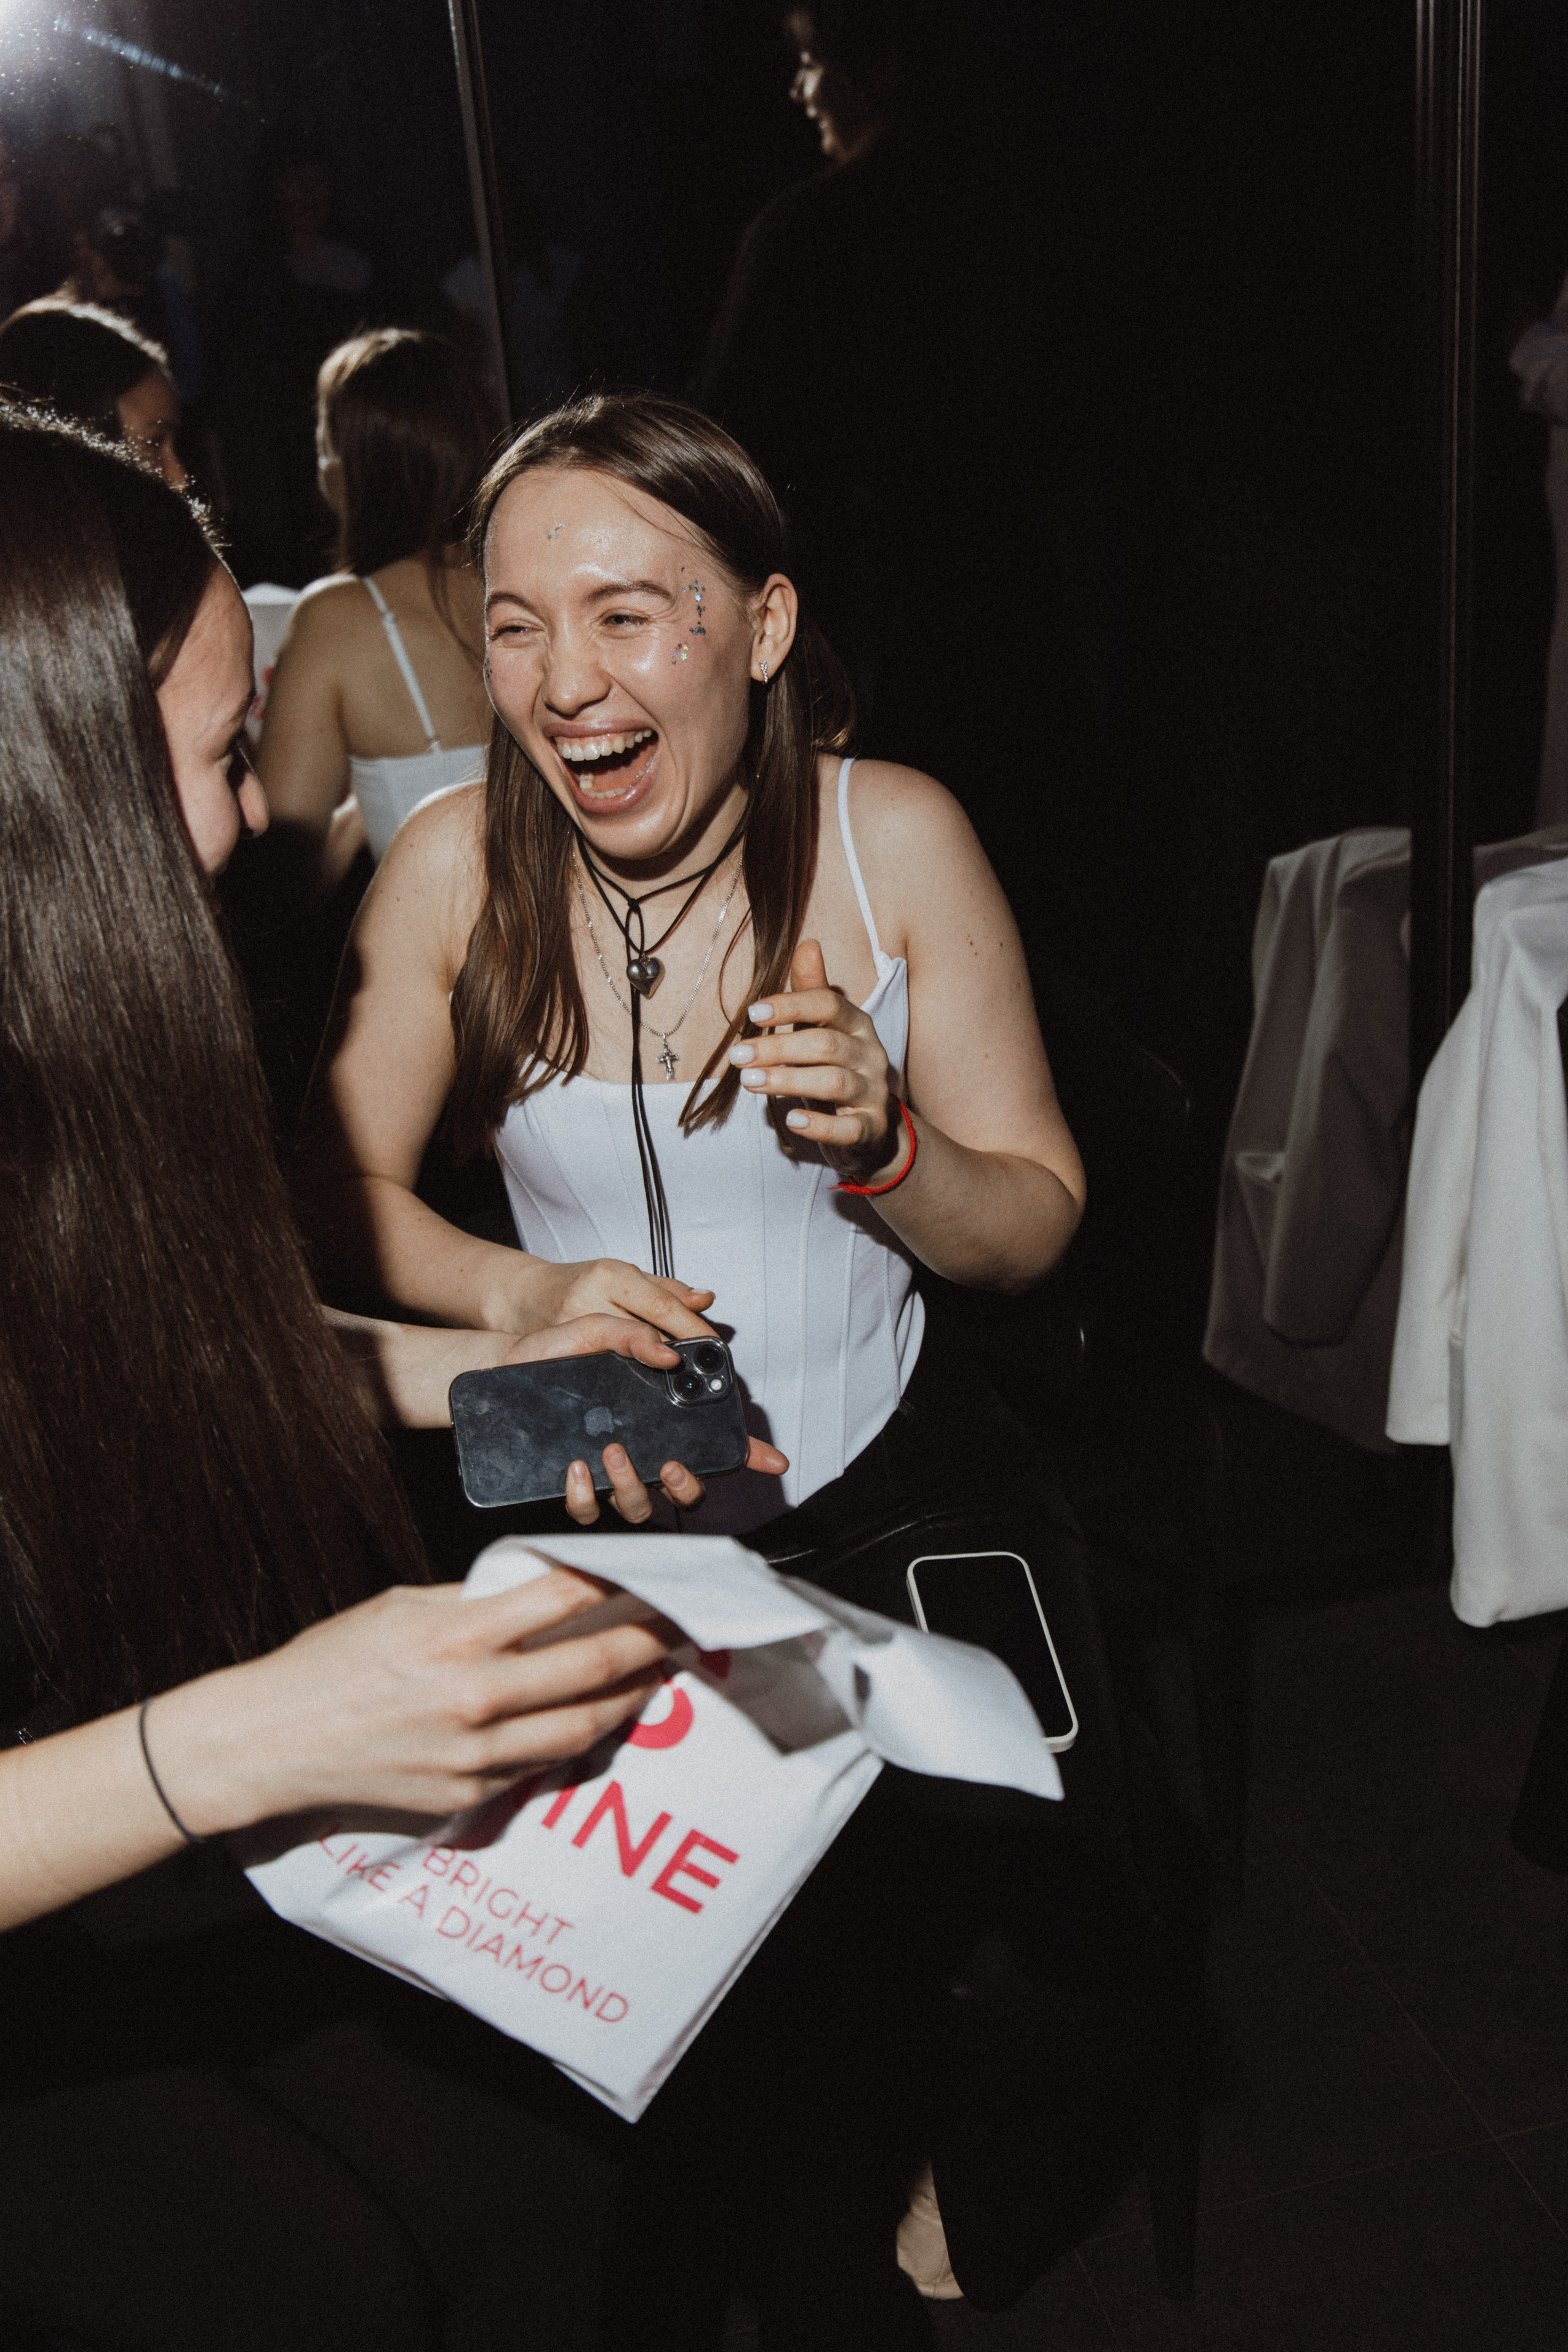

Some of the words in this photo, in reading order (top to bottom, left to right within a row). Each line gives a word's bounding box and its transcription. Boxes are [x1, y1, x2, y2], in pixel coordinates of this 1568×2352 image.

[423, 1844, 573, 1944] BRIGHT
[514, 1764, 739, 1915] INE
[317, 1824, 401, 1891] LIKE
[401, 1885, 429, 1918] A
[436, 1906, 629, 2023] DIAMOND
